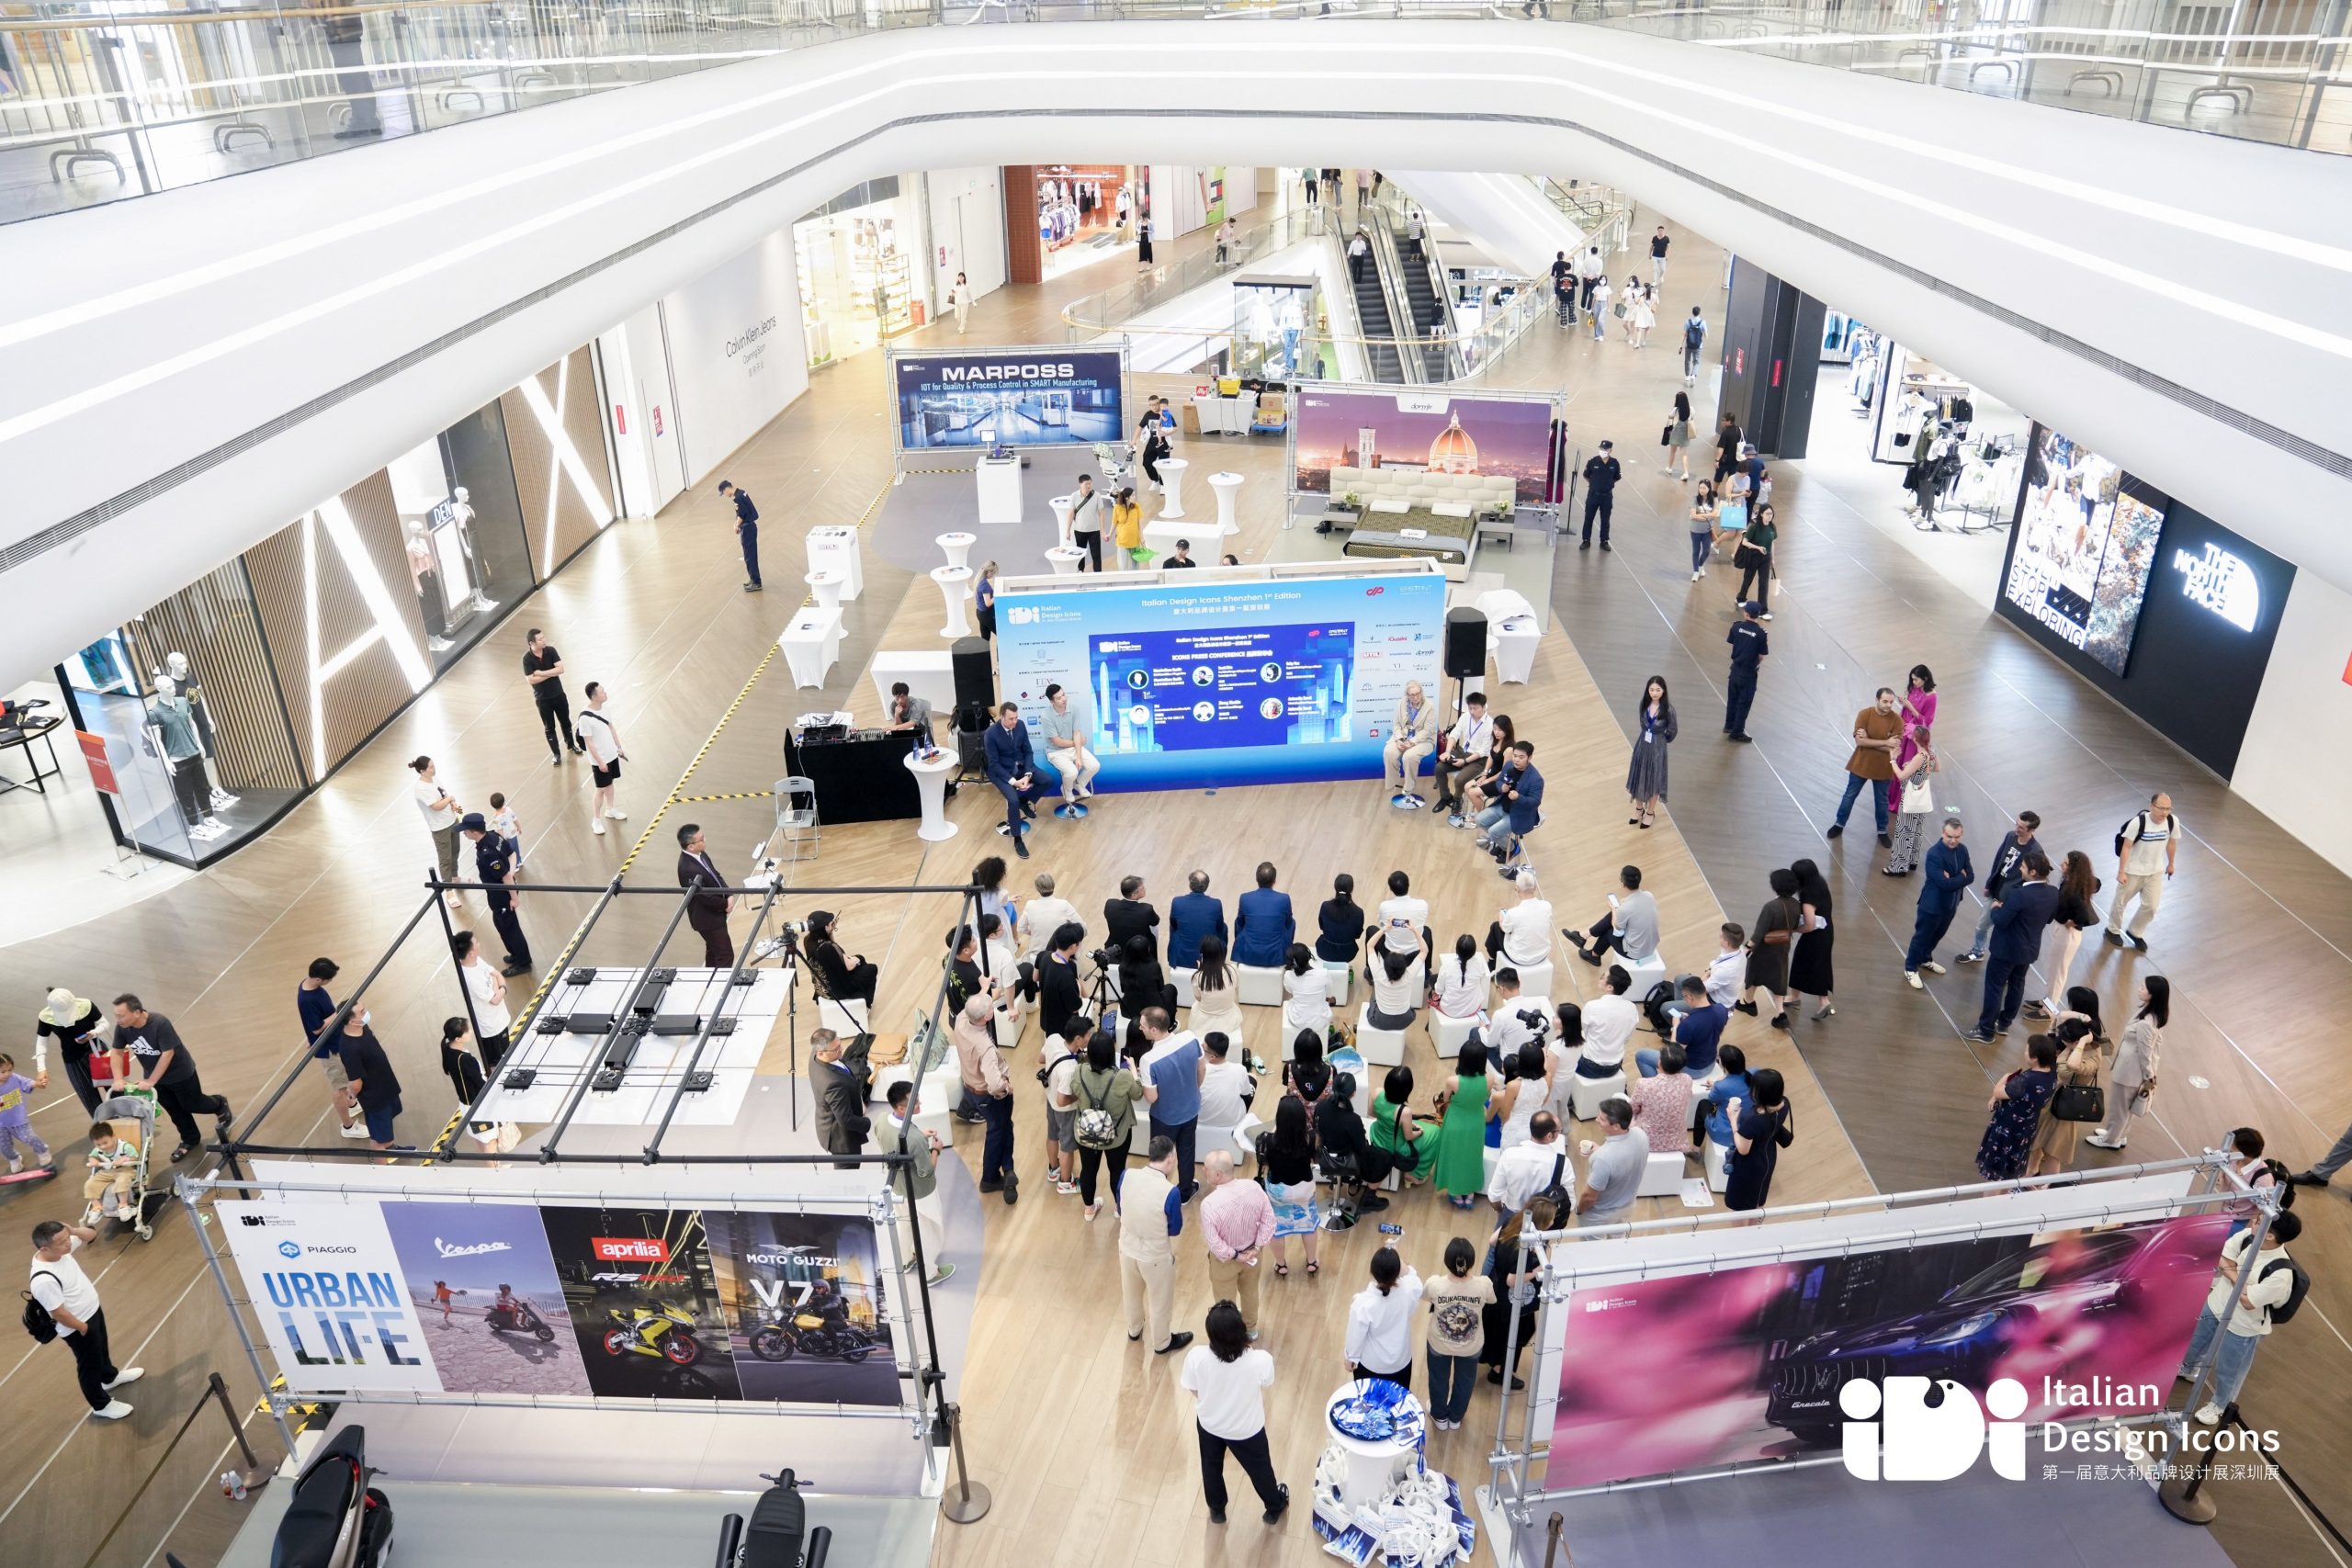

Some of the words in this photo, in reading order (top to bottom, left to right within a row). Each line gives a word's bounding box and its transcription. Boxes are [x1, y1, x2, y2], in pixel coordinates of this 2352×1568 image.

[727, 335, 746, 357] Calvin
[745, 327, 761, 345] Klein
[760, 316, 776, 336] Jeans
[921, 383, 931, 391] IOT
[932, 382, 941, 391] for
[943, 381, 965, 391] Quality
[966, 381, 971, 389] &
[972, 381, 998, 389] Process
[999, 379, 1022, 389] Control
[1023, 379, 1029, 388] in
[1030, 378, 1051, 388] SMART
[1052, 378, 1098, 388] Manufacturing
[942, 363, 1074, 381] MARPOSS
[2173, 548, 2228, 593] NORTH
[2204, 542, 2236, 572] THE
[2010, 564, 2047, 596] STOP
[2183, 573, 2226, 611] FACE
[1170, 598, 1198, 607] Design
[1199, 596, 1221, 604] Icons
[1223, 592, 1263, 603] Shenzhen
[1274, 592, 1301, 600] Edition
[2007, 583, 2085, 649] EXPLORING
[308, 1246, 357, 1254] PIAGGIO
[435, 1236, 512, 1258] Vespa
[602, 1241, 662, 1258] aprilia
[746, 1253, 788, 1265] MOTO
[793, 1256, 838, 1268] GUZZI
[262, 1272, 401, 1308] URBAN
[749, 1279, 815, 1308] V7
[277, 1311, 422, 1366] LIFE
[1791, 1399, 1831, 1409] Grecale
